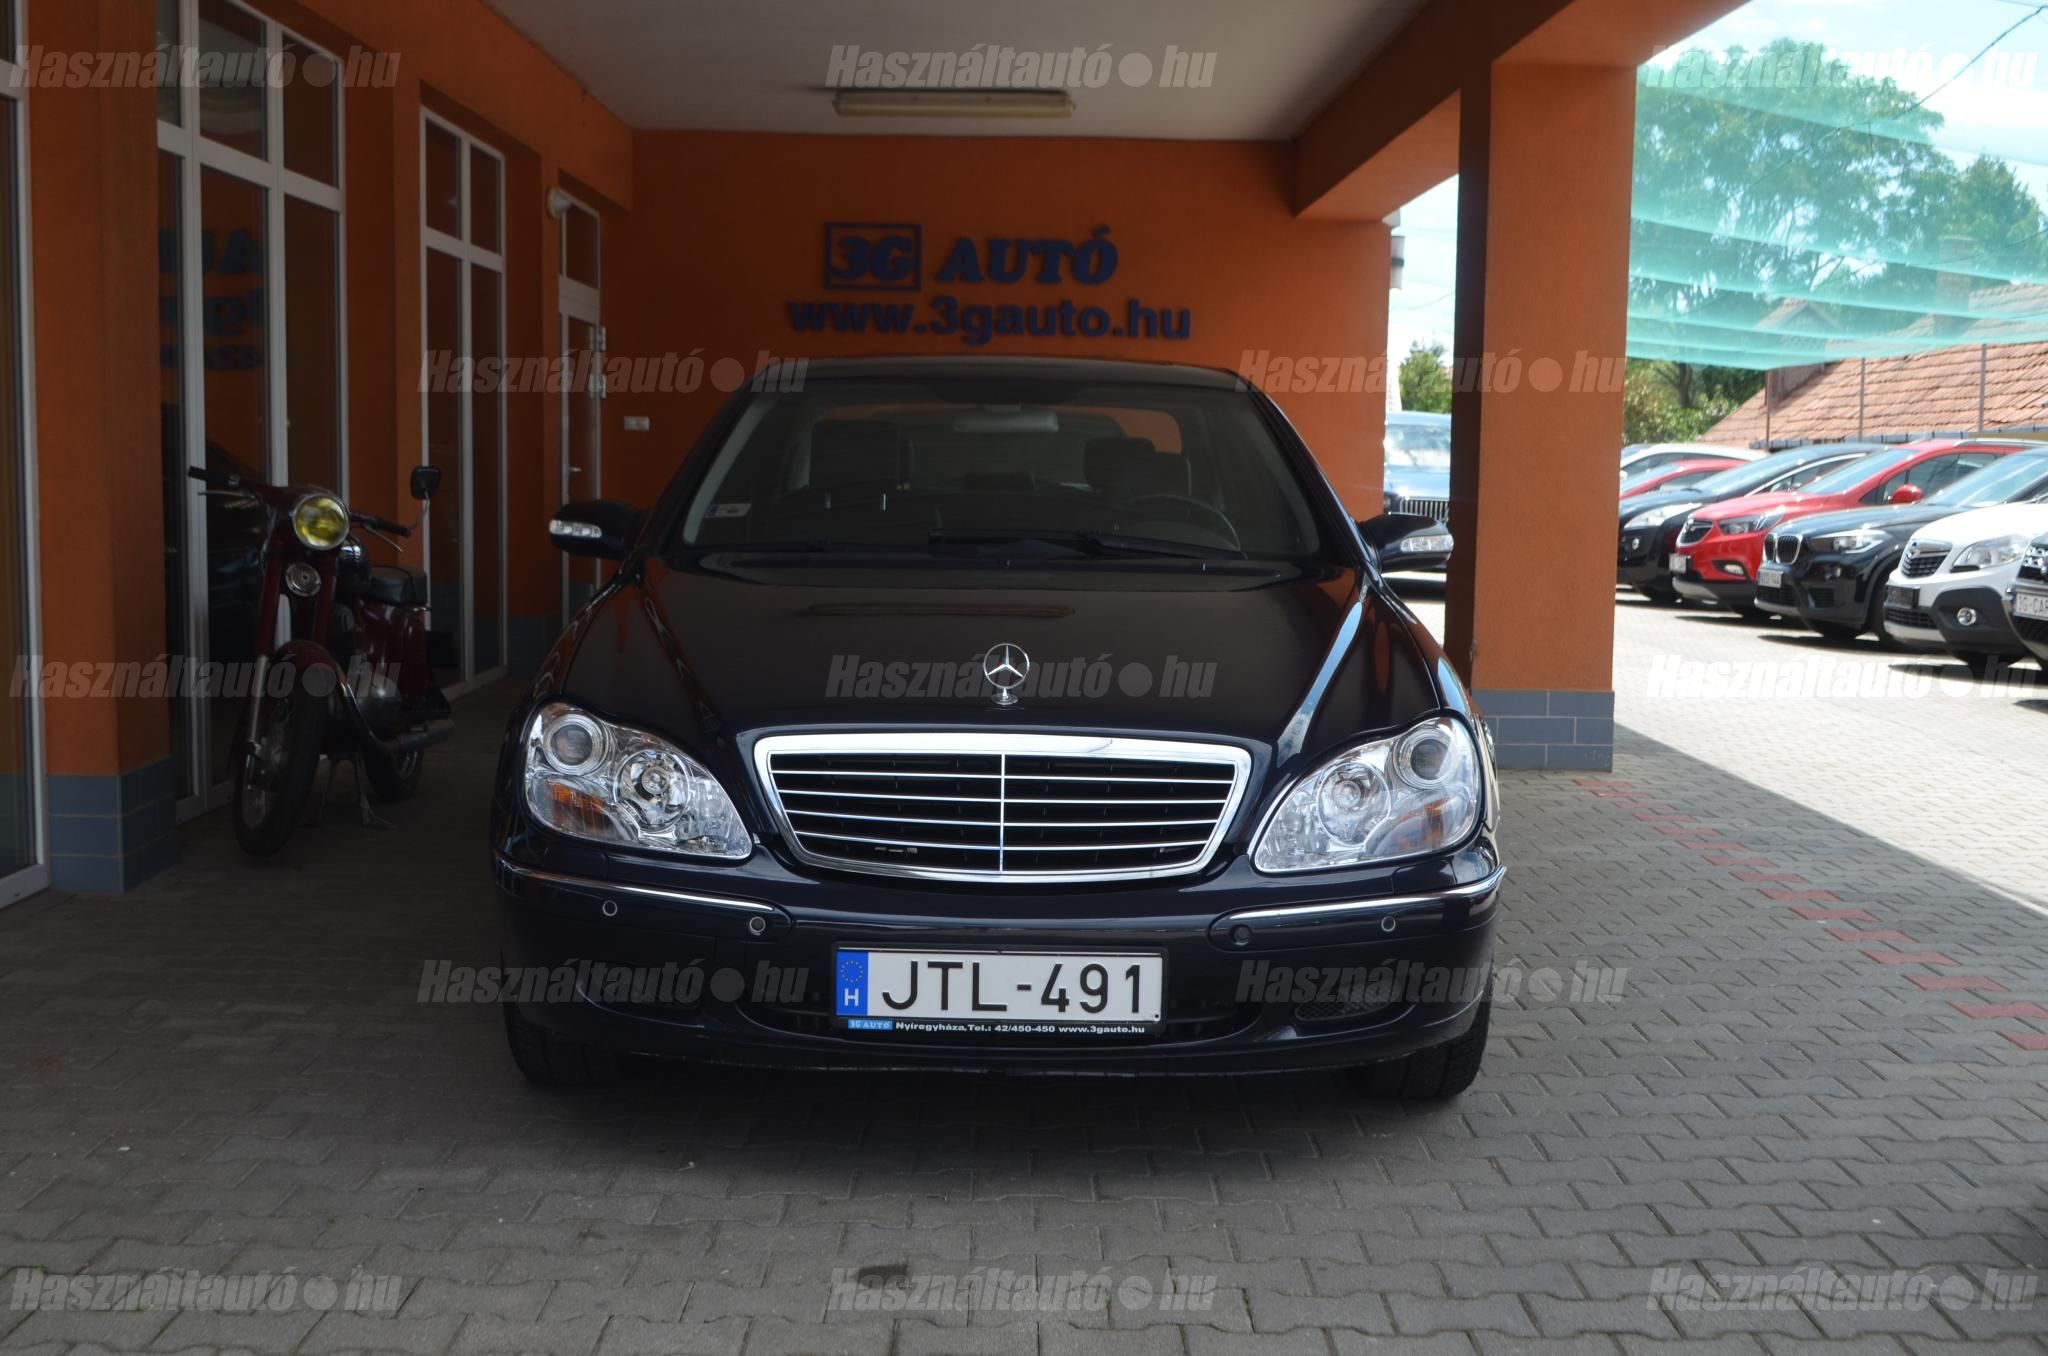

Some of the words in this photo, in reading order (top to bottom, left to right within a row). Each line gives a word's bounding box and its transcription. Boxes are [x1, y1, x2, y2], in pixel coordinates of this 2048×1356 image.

[830, 235, 915, 282] 3G
[934, 226, 1119, 285] AUTÓ
[787, 295, 1191, 346] www.3gauto.hu
[844, 987, 859, 1007] H
[881, 960, 1141, 1014] JTL-491
[994, 1024, 1056, 1032] 42/450-450
[1058, 1025, 1146, 1034] www.3gauto.hu
